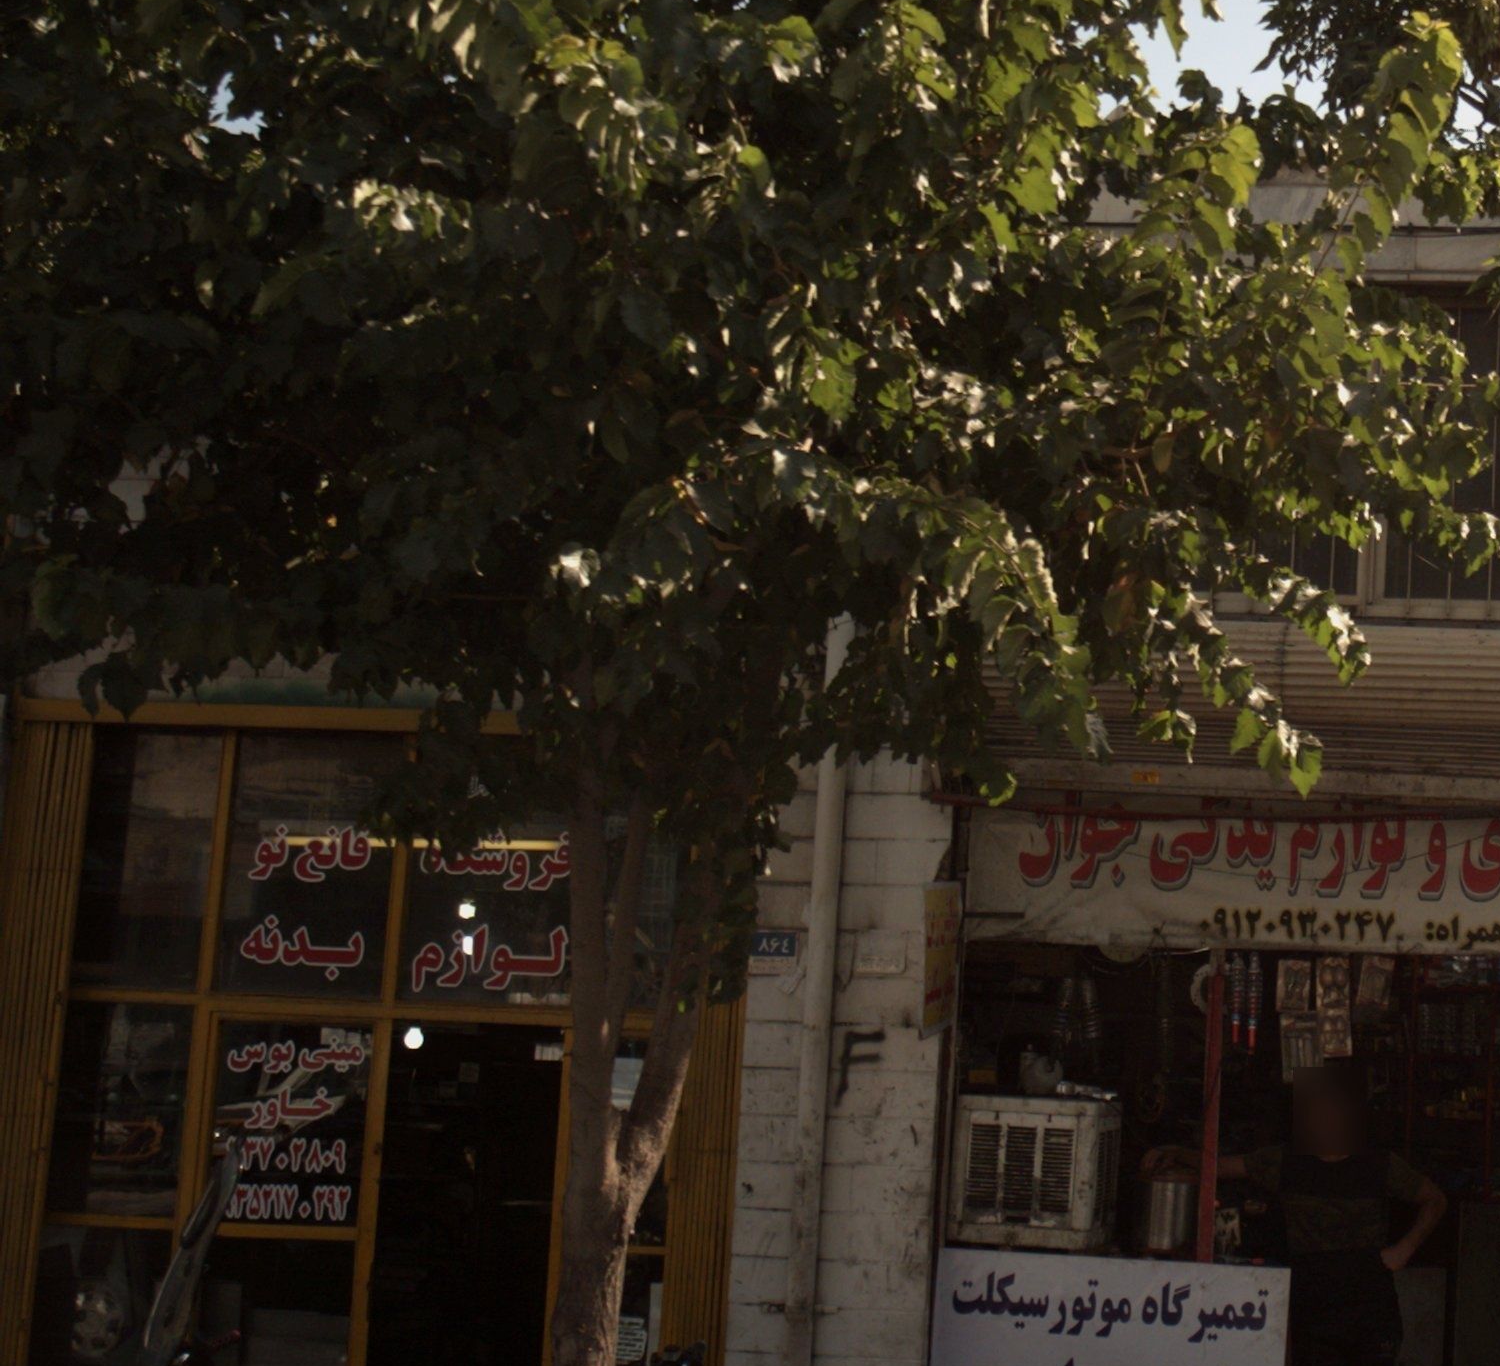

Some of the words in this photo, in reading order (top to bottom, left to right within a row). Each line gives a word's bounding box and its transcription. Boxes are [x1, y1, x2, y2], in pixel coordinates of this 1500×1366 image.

[1018, 790, 1141, 887] جوان
[1418, 821, 1447, 901] و
[240, 914, 365, 982] بدنه
[411, 923, 570, 993] لوازم
[298, 1035, 365, 1073] مینی
[244, 1086, 335, 1129] خاور
[227, 1136, 346, 1175] ۳۷۰۲۸۰۹
[952, 1271, 1050, 1330] سیکلت
[1048, 1278, 1132, 1338] موتور
